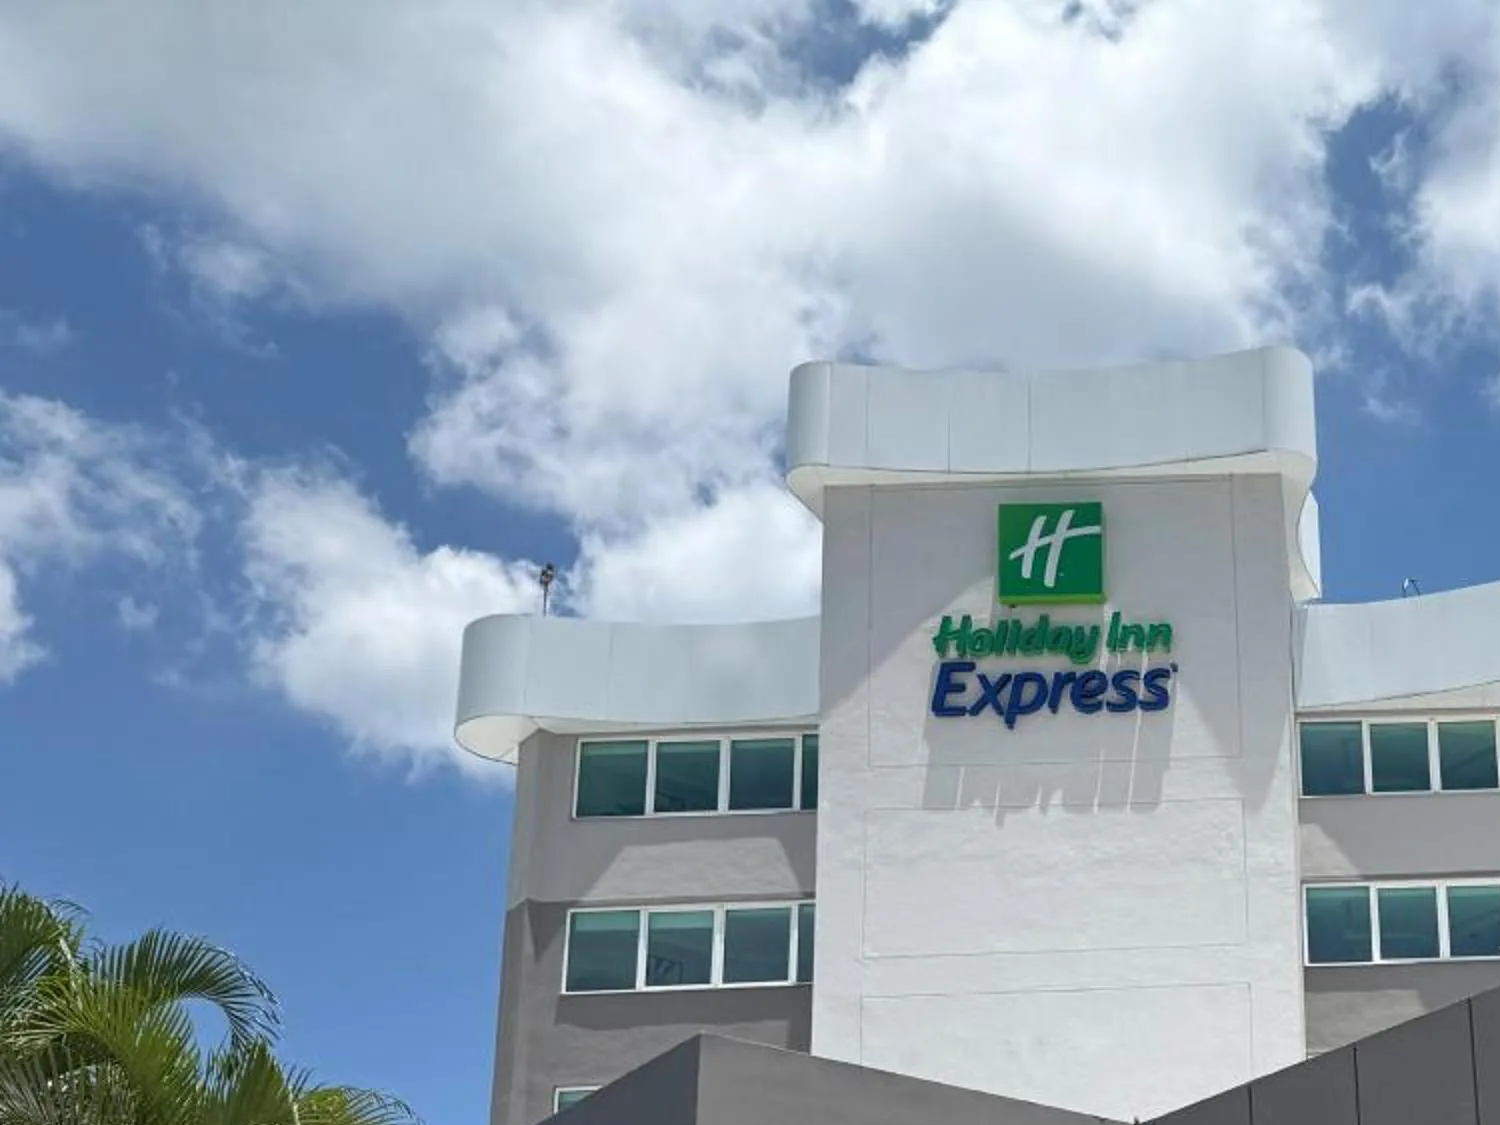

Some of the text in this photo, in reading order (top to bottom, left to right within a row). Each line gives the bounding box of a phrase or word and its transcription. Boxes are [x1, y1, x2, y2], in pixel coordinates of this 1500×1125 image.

[932, 611, 1173, 665] Holiday Inn
[931, 661, 1171, 730] Express
